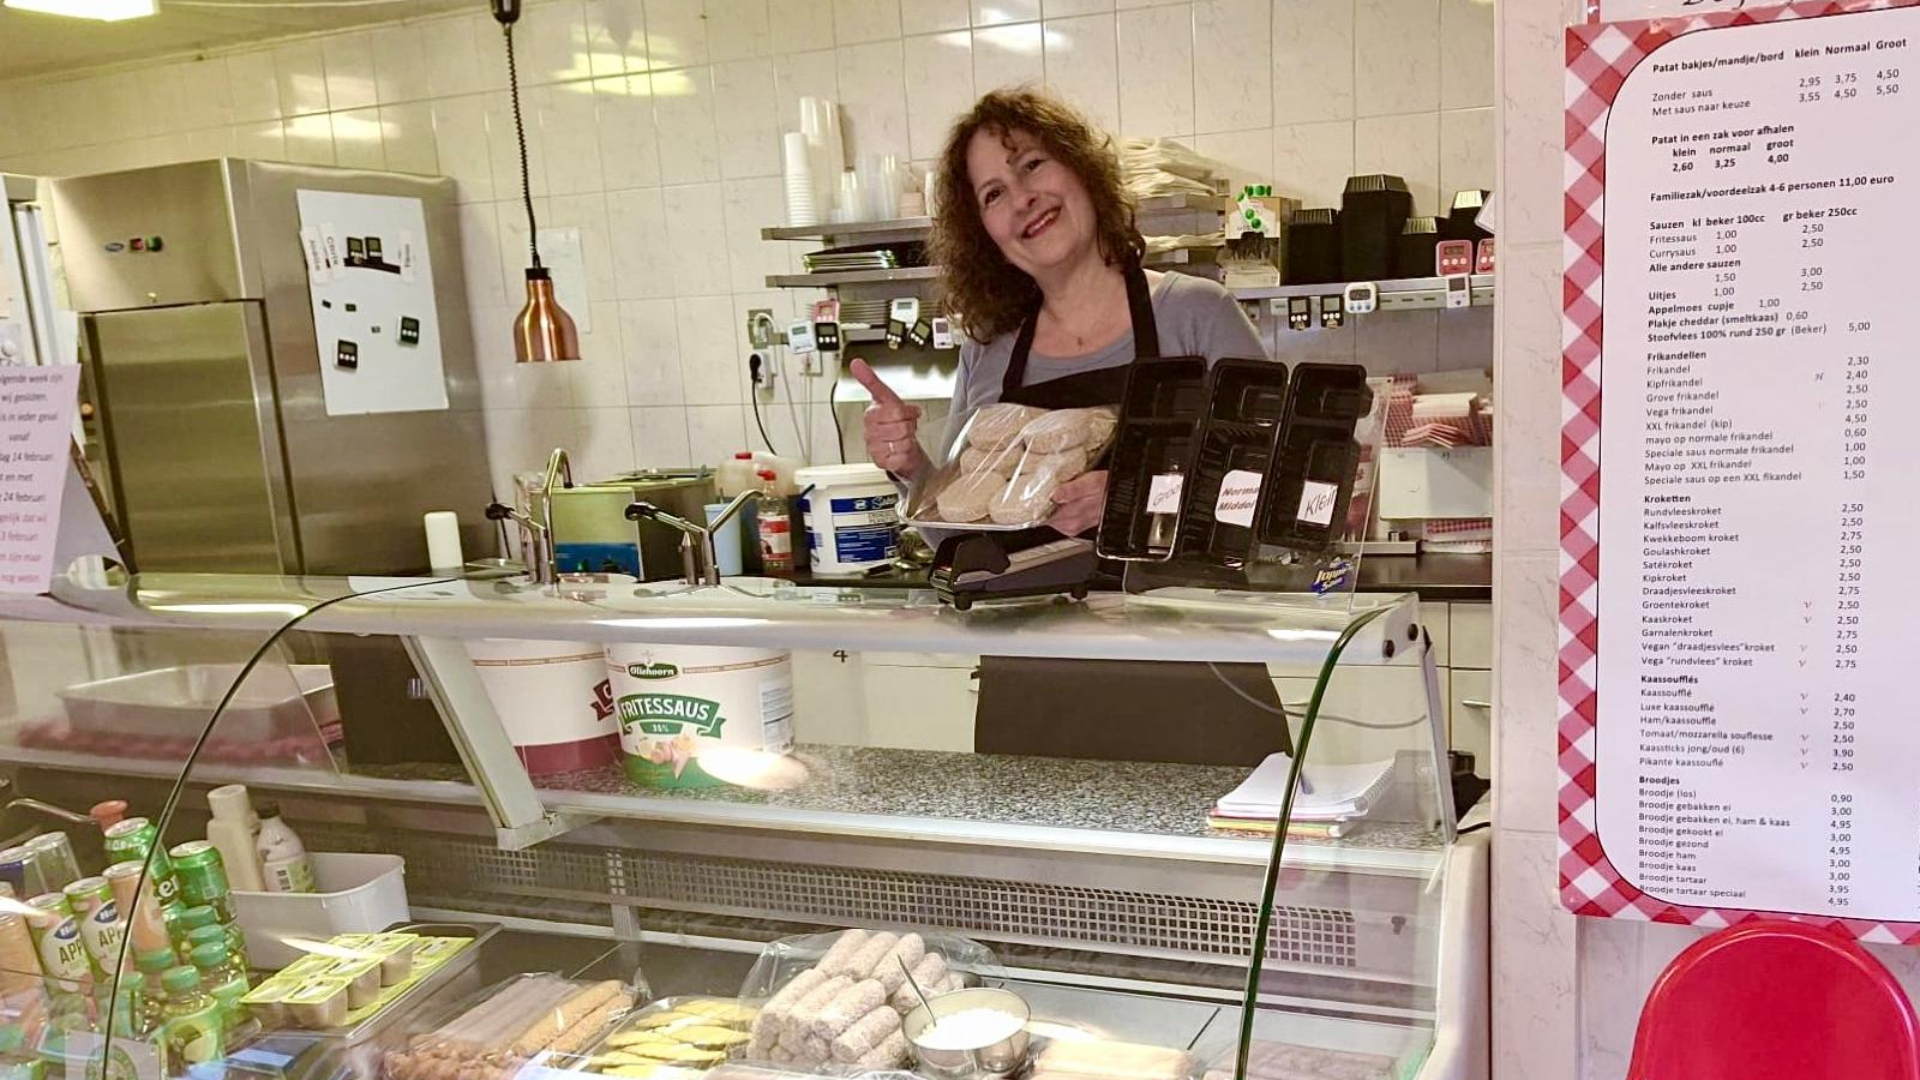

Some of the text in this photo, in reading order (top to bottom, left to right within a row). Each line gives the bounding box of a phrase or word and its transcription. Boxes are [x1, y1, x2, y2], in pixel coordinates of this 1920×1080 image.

[1652, 63, 1679, 73] Patat
[1794, 48, 1820, 58] klein
[1825, 41, 1871, 55] Normaal
[1875, 38, 1907, 50] Groot
[1799, 68, 1900, 88] 2,95 3,75 4,50
[1652, 89, 1713, 102] Zonder saus
[1799, 83, 1900, 103] 3,55 4,50 5,50
[1652, 100, 1751, 116] Met saus naar keuze
[1651, 135, 1678, 145] Patat
[1680, 134, 1690, 142] in
[1691, 133, 1711, 142] een
[1712, 130, 1729, 140] zak
[1731, 129, 1755, 138] voor
[1672, 139, 1794, 157] klein normaal groot
[1672, 153, 1789, 173] 2,60 3,25 4,00
[1769, 182, 1786, 192] 4-6
[1787, 180, 1836, 193] personen
[1839, 176, 1868, 187] 11,00
[1869, 175, 1895, 185] euro
[1782, 207, 1858, 223] gr beker 250cc
[1649, 221, 1685, 230] Sauzen
[1705, 216, 1735, 226] beker
[1736, 214, 1765, 224] 100cc
[1801, 223, 1824, 234] 2,50
[1716, 229, 1738, 240] 1,00
[1649, 260, 1741, 272] Alle andere sauzen
[1715, 272, 1736, 283] 1,50
[1800, 266, 1823, 278] 3,00
[1714, 286, 1735, 297] 1,00
[1801, 281, 1824, 292] 2,50
[1648, 291, 1677, 302] Uitjes
[1648, 301, 1735, 316] Appelmoes cupje
[1759, 298, 1781, 308] 1,00
[1648, 312, 1779, 329] Plakje cheddar (smeltkaas)
[1785, 310, 1809, 321] 0,60
[1647, 323, 1827, 343] Stoofvlees 100% rund 250 gr (Beker)
[1848, 322, 1871, 333] 5,00
[1647, 350, 1707, 362] Frikandellen
[1847, 356, 1870, 367] 2,30
[1646, 364, 1691, 375] Frikandel
[1846, 369, 1868, 380] 2,40
[1646, 378, 1703, 390] Kipfrikandel
[1846, 384, 1868, 394] 2,50
[1676, 390, 1719, 401] frikandel
[1845, 399, 1868, 410] 2,50
[1645, 405, 1713, 418] Vega frikandel
[1845, 413, 1867, 425] 4,50
[1645, 419, 1733, 431] XXL frikandel (kip)
[1645, 431, 1773, 446] mayo op normale frikandel
[1844, 428, 1867, 438] 0,60
[1644, 449, 1683, 459] Speciale
[1709, 446, 1749, 456] normale
[1751, 444, 1794, 454] frikandel
[1845, 442, 1866, 452] 1,00
[1844, 455, 1866, 467] 1,00
[1643, 506, 1722, 517] Rundvleeskroket
[1841, 503, 1864, 514] 2,50
[1841, 517, 1864, 528] 2,50
[1643, 534, 1739, 544] Kwekkeboom kroket
[1840, 531, 1863, 541] 2,75
[1642, 546, 1711, 556] Goulashkroket
[1839, 544, 1862, 555] 2,50
[1839, 558, 1862, 569] 2,50
[1642, 573, 1687, 583] Kipkroket
[1839, 572, 1861, 582] 2,50
[1838, 586, 1860, 596] 2,75
[1641, 600, 1710, 609] Groentekroket
[1837, 600, 1860, 610] 2,50
[1642, 615, 1692, 624] Kaaskroket
[1837, 616, 1859, 625] 2,50
[1641, 628, 1713, 637] Garnalenkroket
[1836, 630, 1858, 640] 2,75
[1641, 642, 1670, 652] Vegan
[1835, 644, 1858, 654] 2,50
[833, 650, 848, 662] 4
[1641, 657, 1664, 667] Vega
[1722, 657, 1753, 666] kroket
[1835, 659, 1857, 670] 2,75
[1834, 693, 1856, 703] 2,40
[620, 697, 710, 720] FRITESSAUS
[1638, 775, 1680, 786] Broodjes
[1638, 788, 1697, 799] Broodje (los)
[1830, 794, 1853, 804] 0,90
[1638, 800, 1674, 811] Broodje
[1676, 802, 1721, 812] gebakken
[1831, 806, 1853, 816] 3,00
